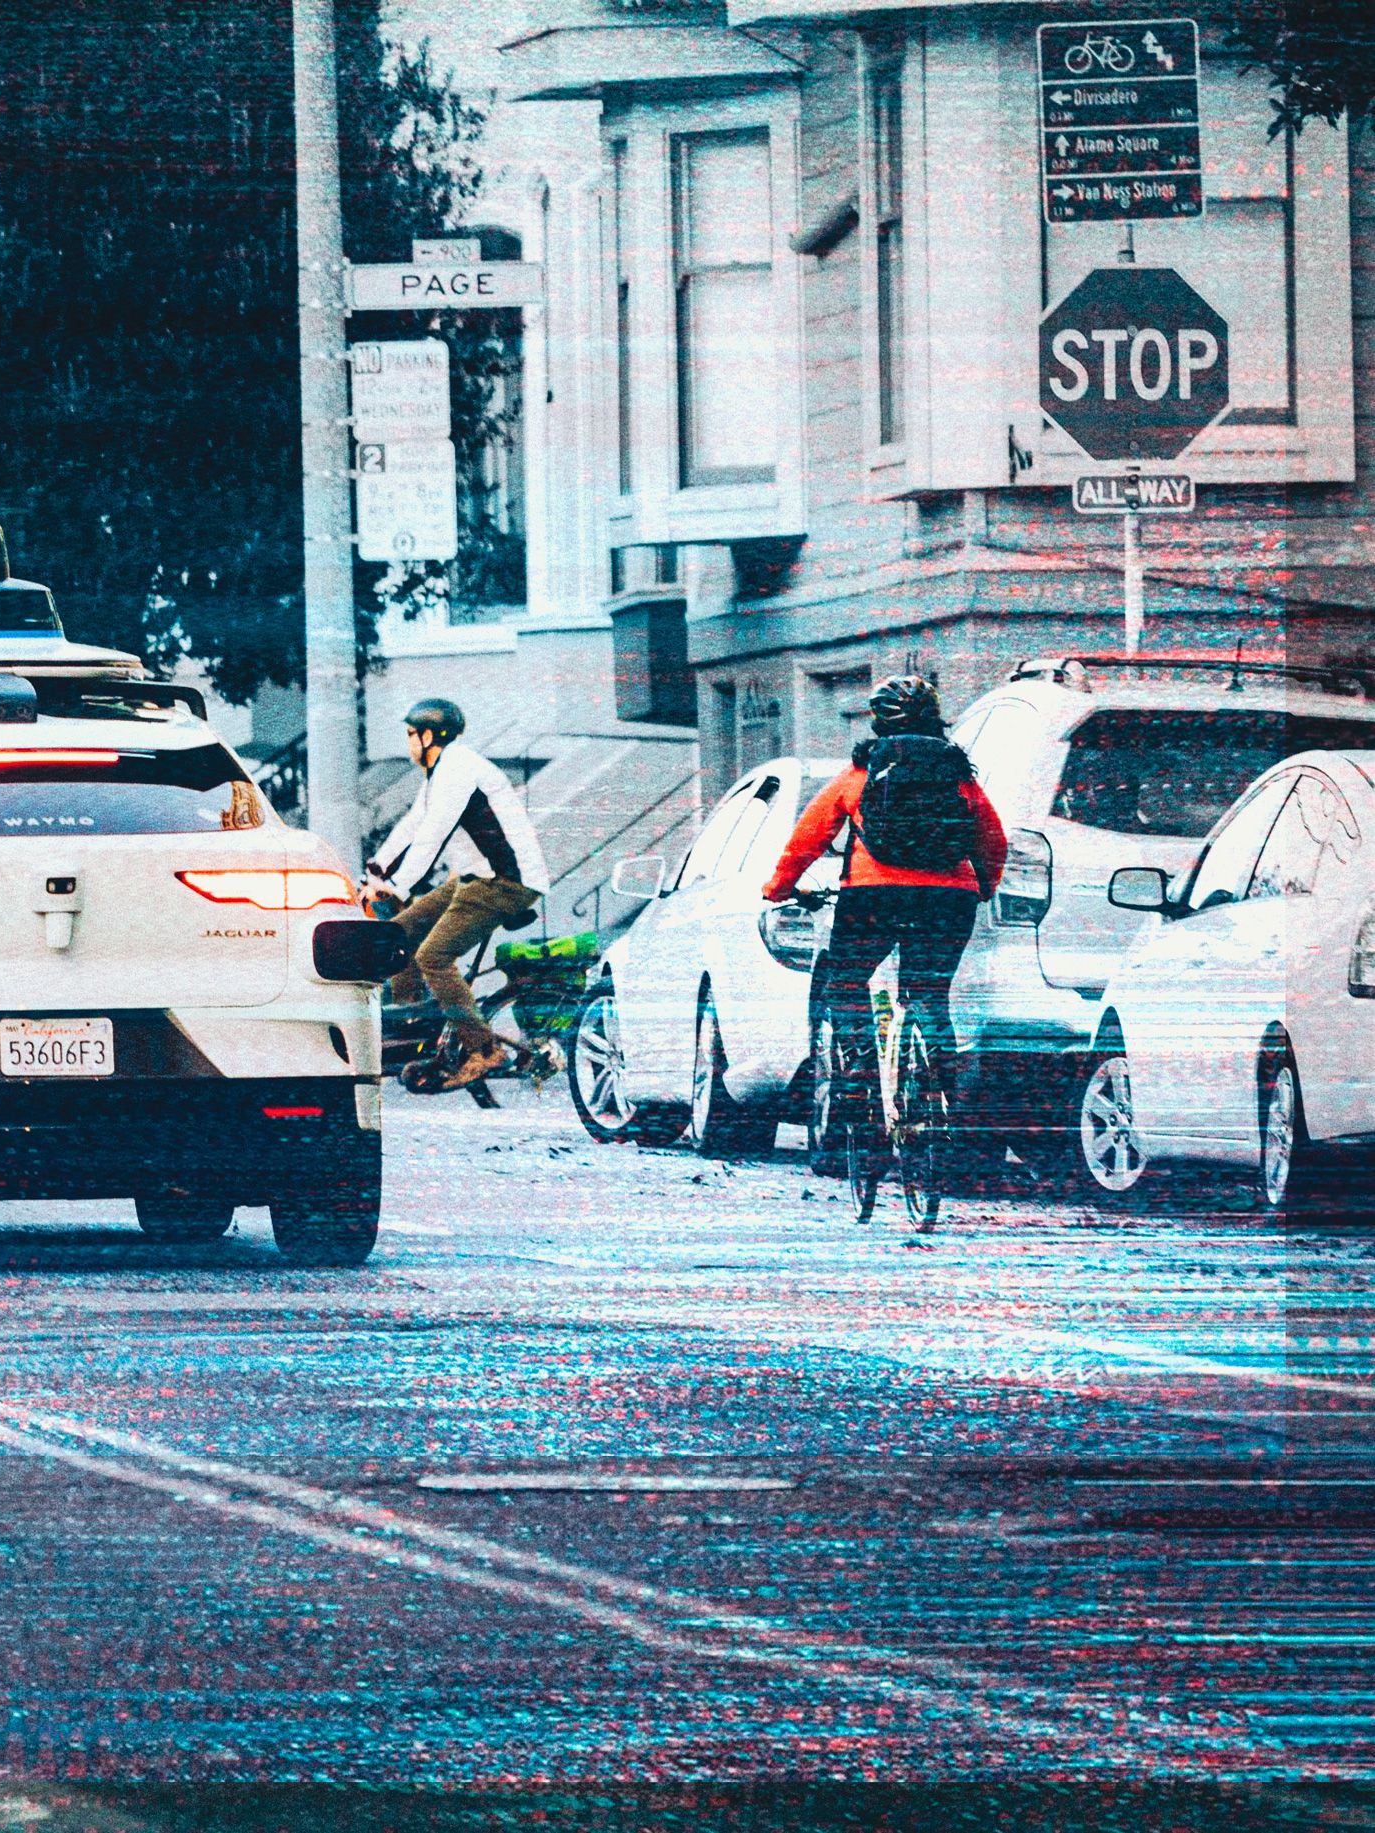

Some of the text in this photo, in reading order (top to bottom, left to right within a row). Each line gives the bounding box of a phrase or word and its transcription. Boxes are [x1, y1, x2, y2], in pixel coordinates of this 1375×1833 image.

[1074, 88, 1138, 106] Divisadero
[1074, 134, 1159, 154] Alamo Square
[1076, 180, 1177, 201] Van Ness Station
[401, 273, 494, 296] PAGE
[1049, 327, 1219, 401] STOP
[363, 446, 381, 472] 2
[1080, 479, 1188, 504] ALL-WAY
[4, 816, 95, 827] WAYMO
[199, 929, 277, 938] JAGUAR
[9, 1040, 105, 1066] 53606F3
